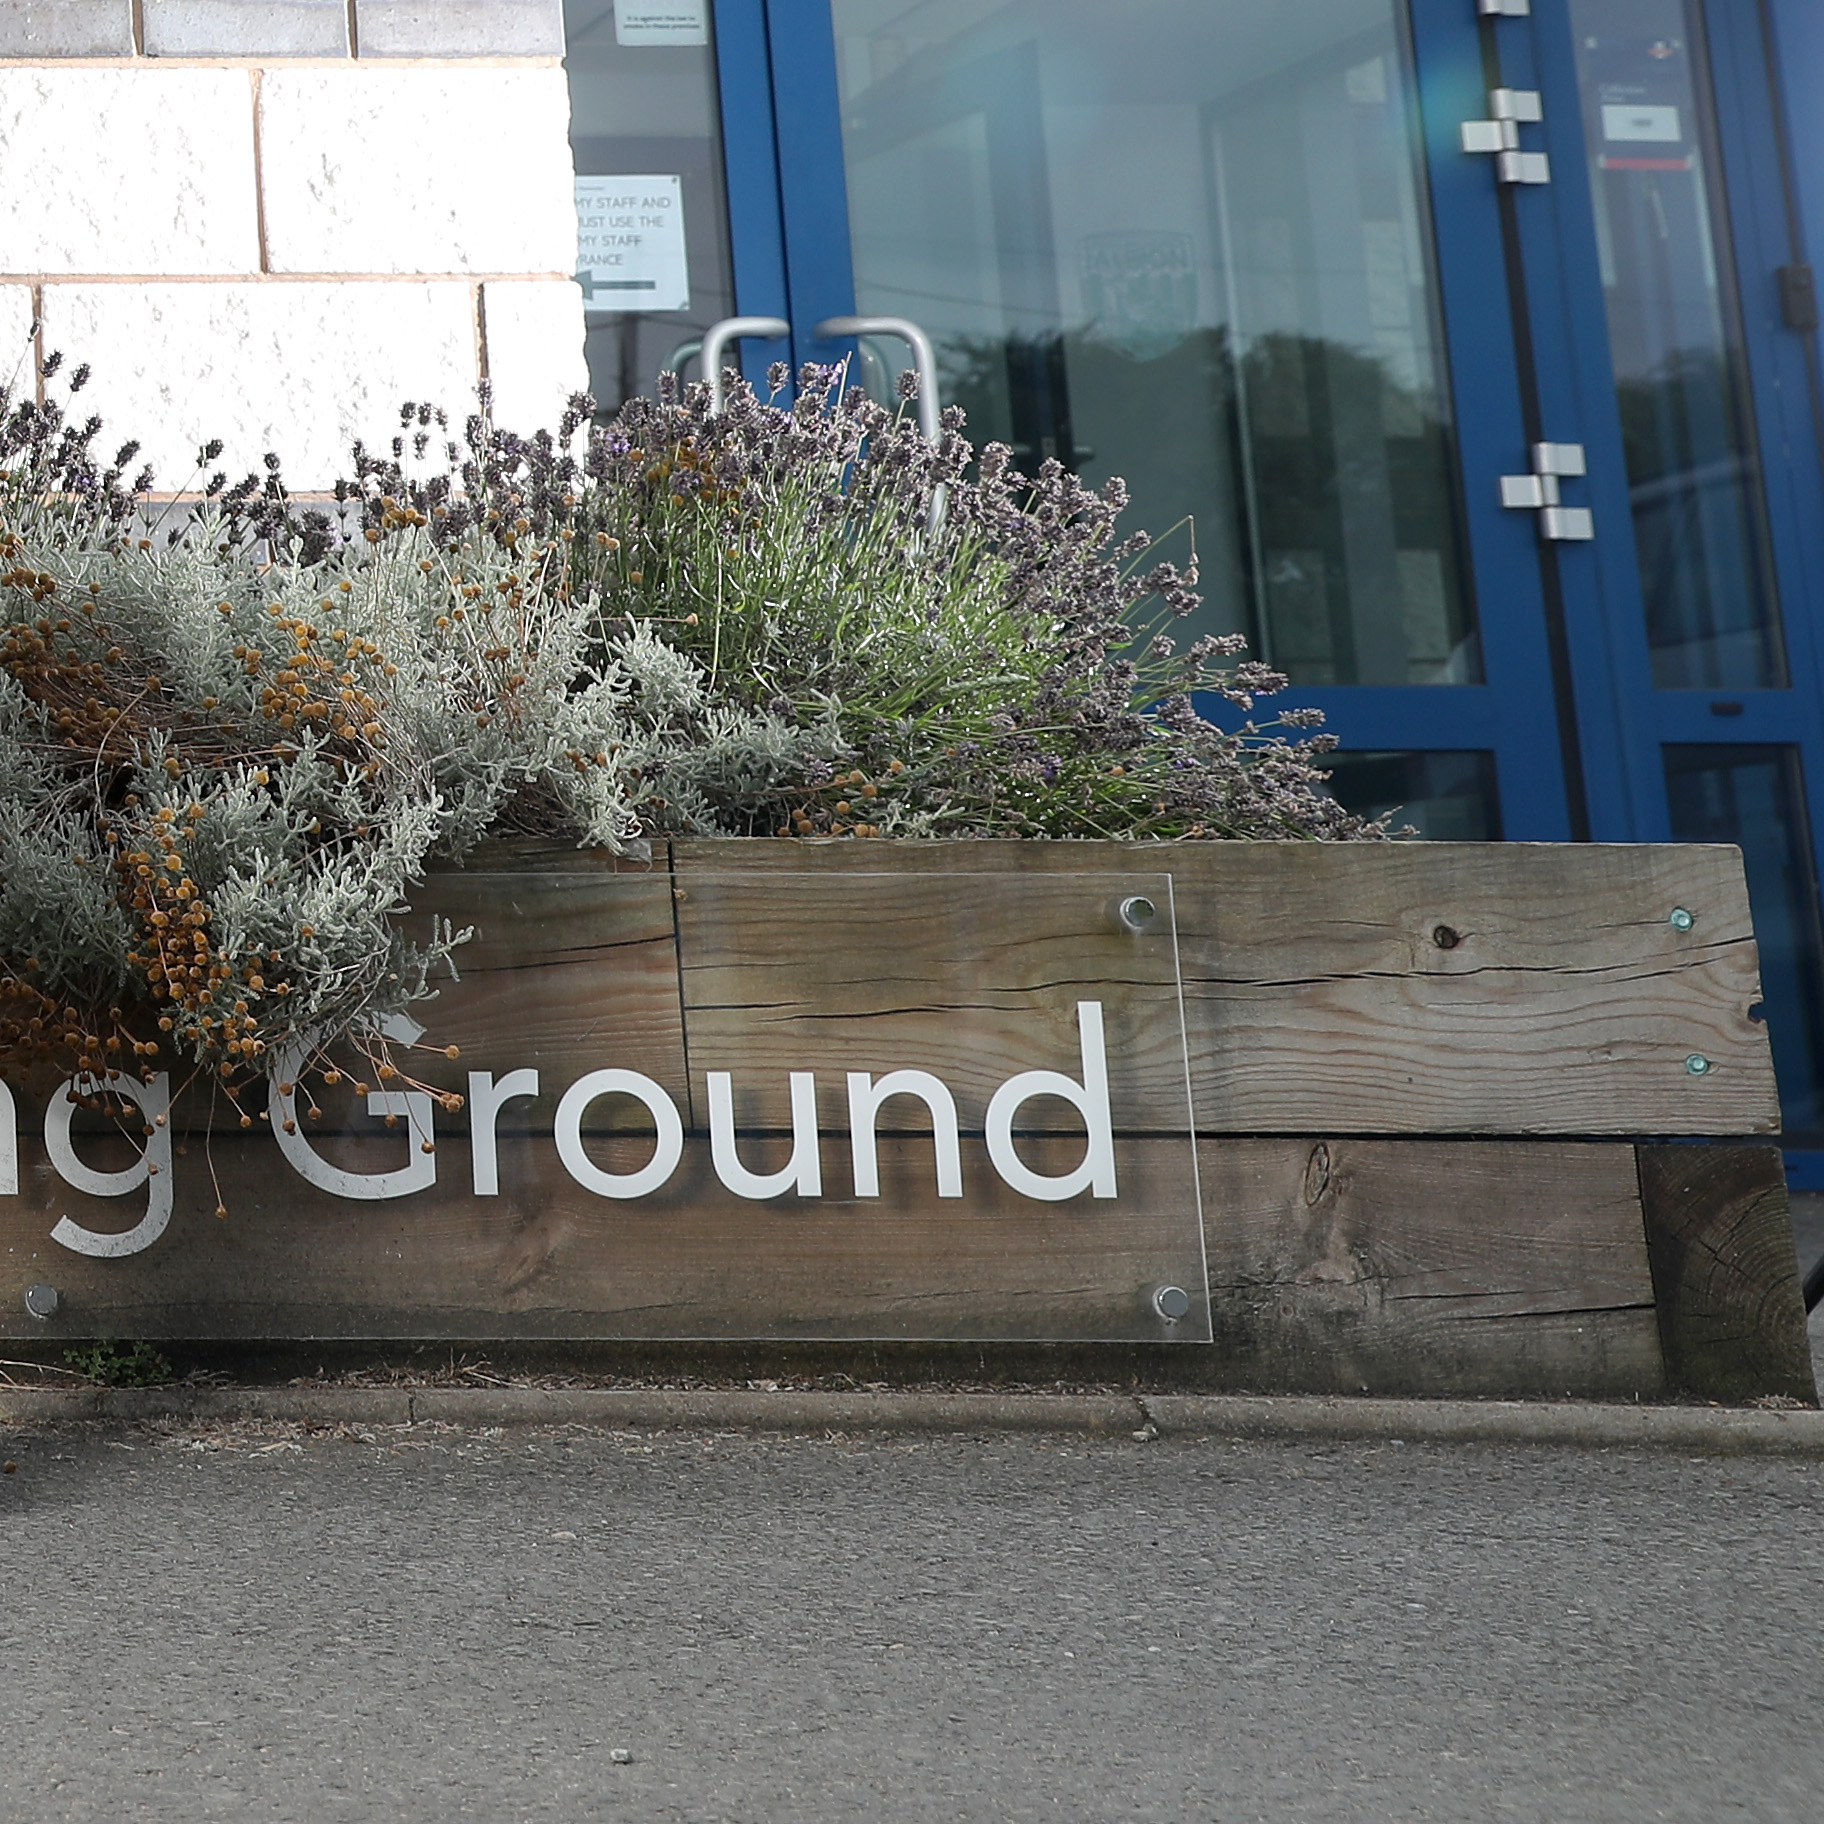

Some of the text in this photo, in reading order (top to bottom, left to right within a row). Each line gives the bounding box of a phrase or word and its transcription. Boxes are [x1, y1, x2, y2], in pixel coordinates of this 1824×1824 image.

[597, 197, 638, 209] STAFF
[641, 197, 672, 209] AND
[609, 216, 635, 228] USE
[638, 216, 664, 228] THE
[601, 234, 643, 247] STAFF
[266, 1000, 1118, 1201] Ground
